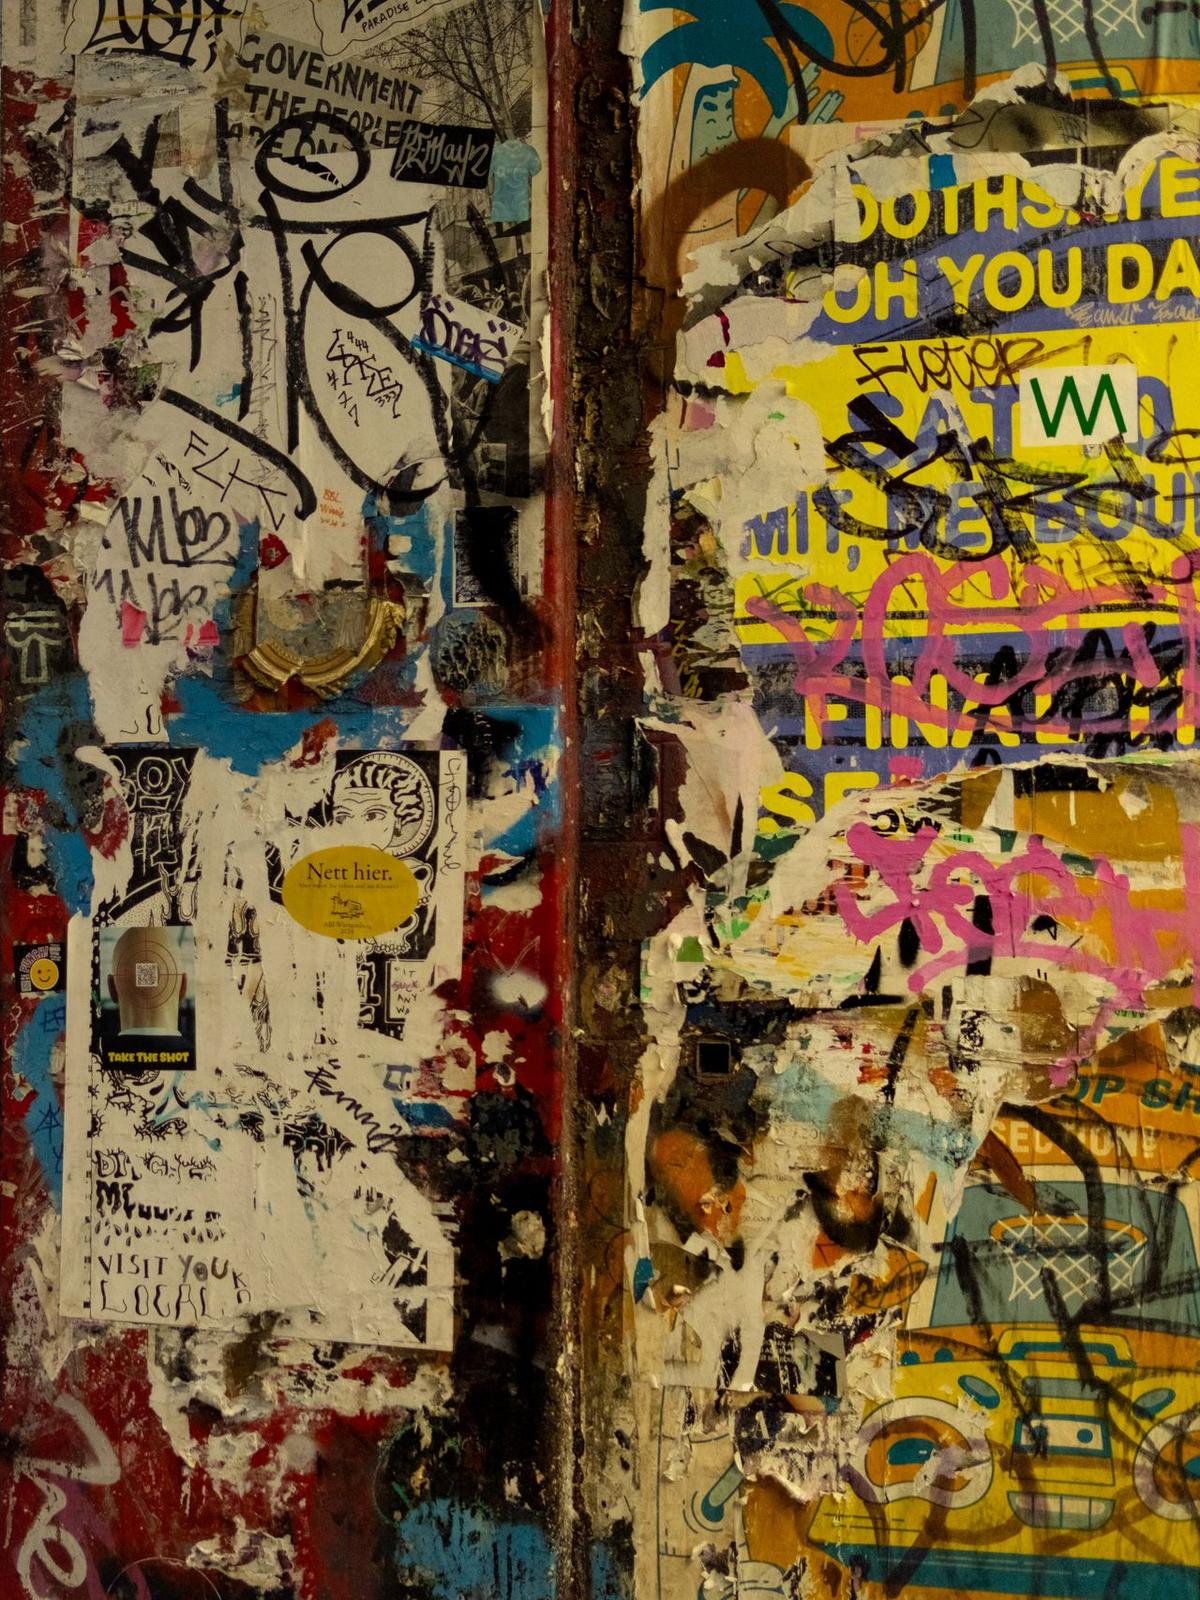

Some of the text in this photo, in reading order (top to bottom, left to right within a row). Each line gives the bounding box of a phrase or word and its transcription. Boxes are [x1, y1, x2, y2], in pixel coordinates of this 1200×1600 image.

[362, 2, 411, 33] PARADISE
[238, 34, 424, 114] GOVERNMENT
[243, 83, 307, 122] THE
[823, 238, 1200, 323] OH YOU DA
[306, 861, 392, 884] Nett hier.
[107, 1051, 190, 1063] TAKE THE SHOT
[98, 1252, 168, 1279] VISIT
